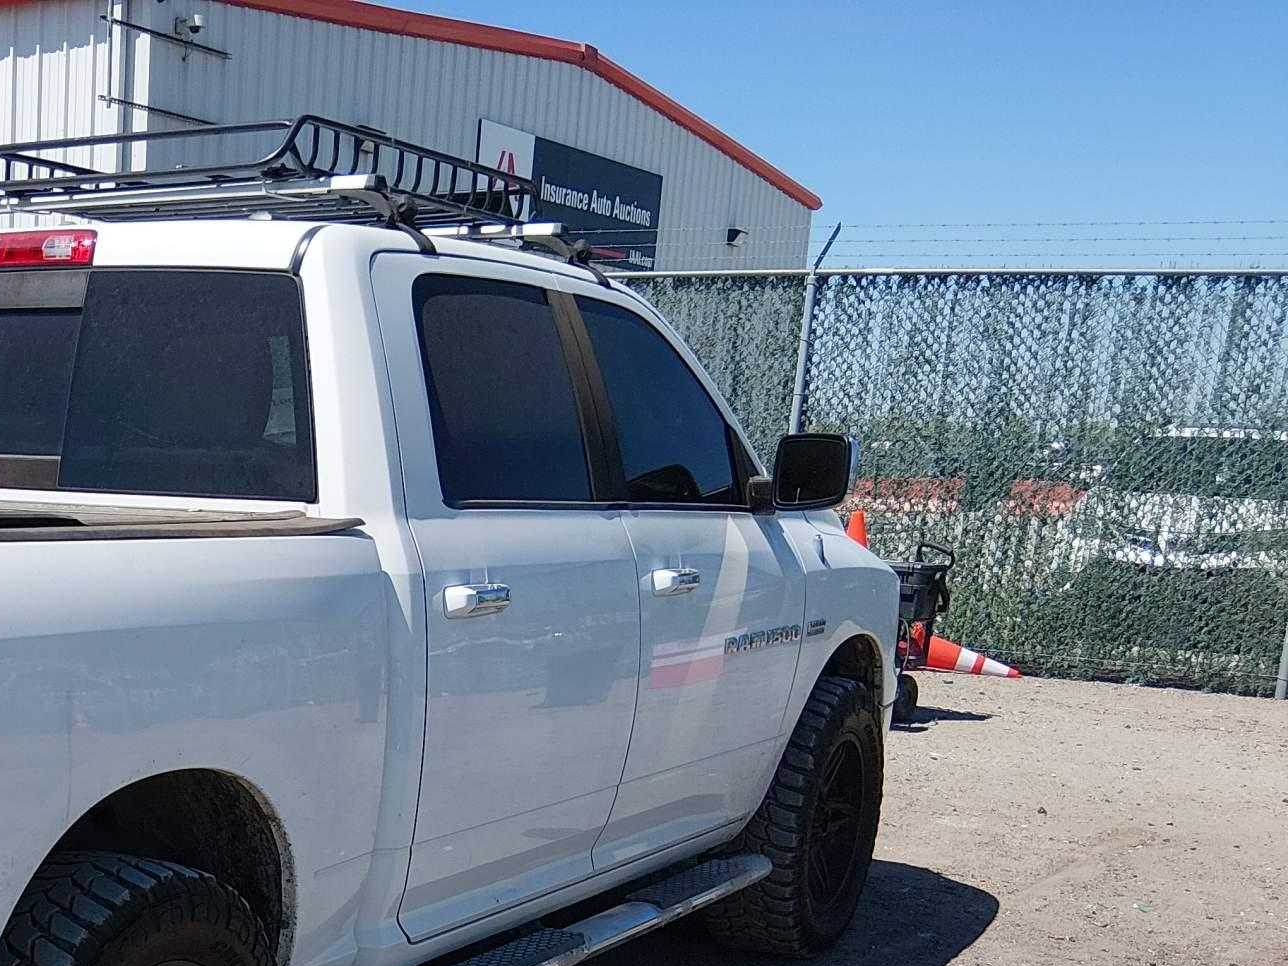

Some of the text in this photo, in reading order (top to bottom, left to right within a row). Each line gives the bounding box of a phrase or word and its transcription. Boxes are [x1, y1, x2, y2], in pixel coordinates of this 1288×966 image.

[540, 175, 651, 227] Insurance Auto Auctions
